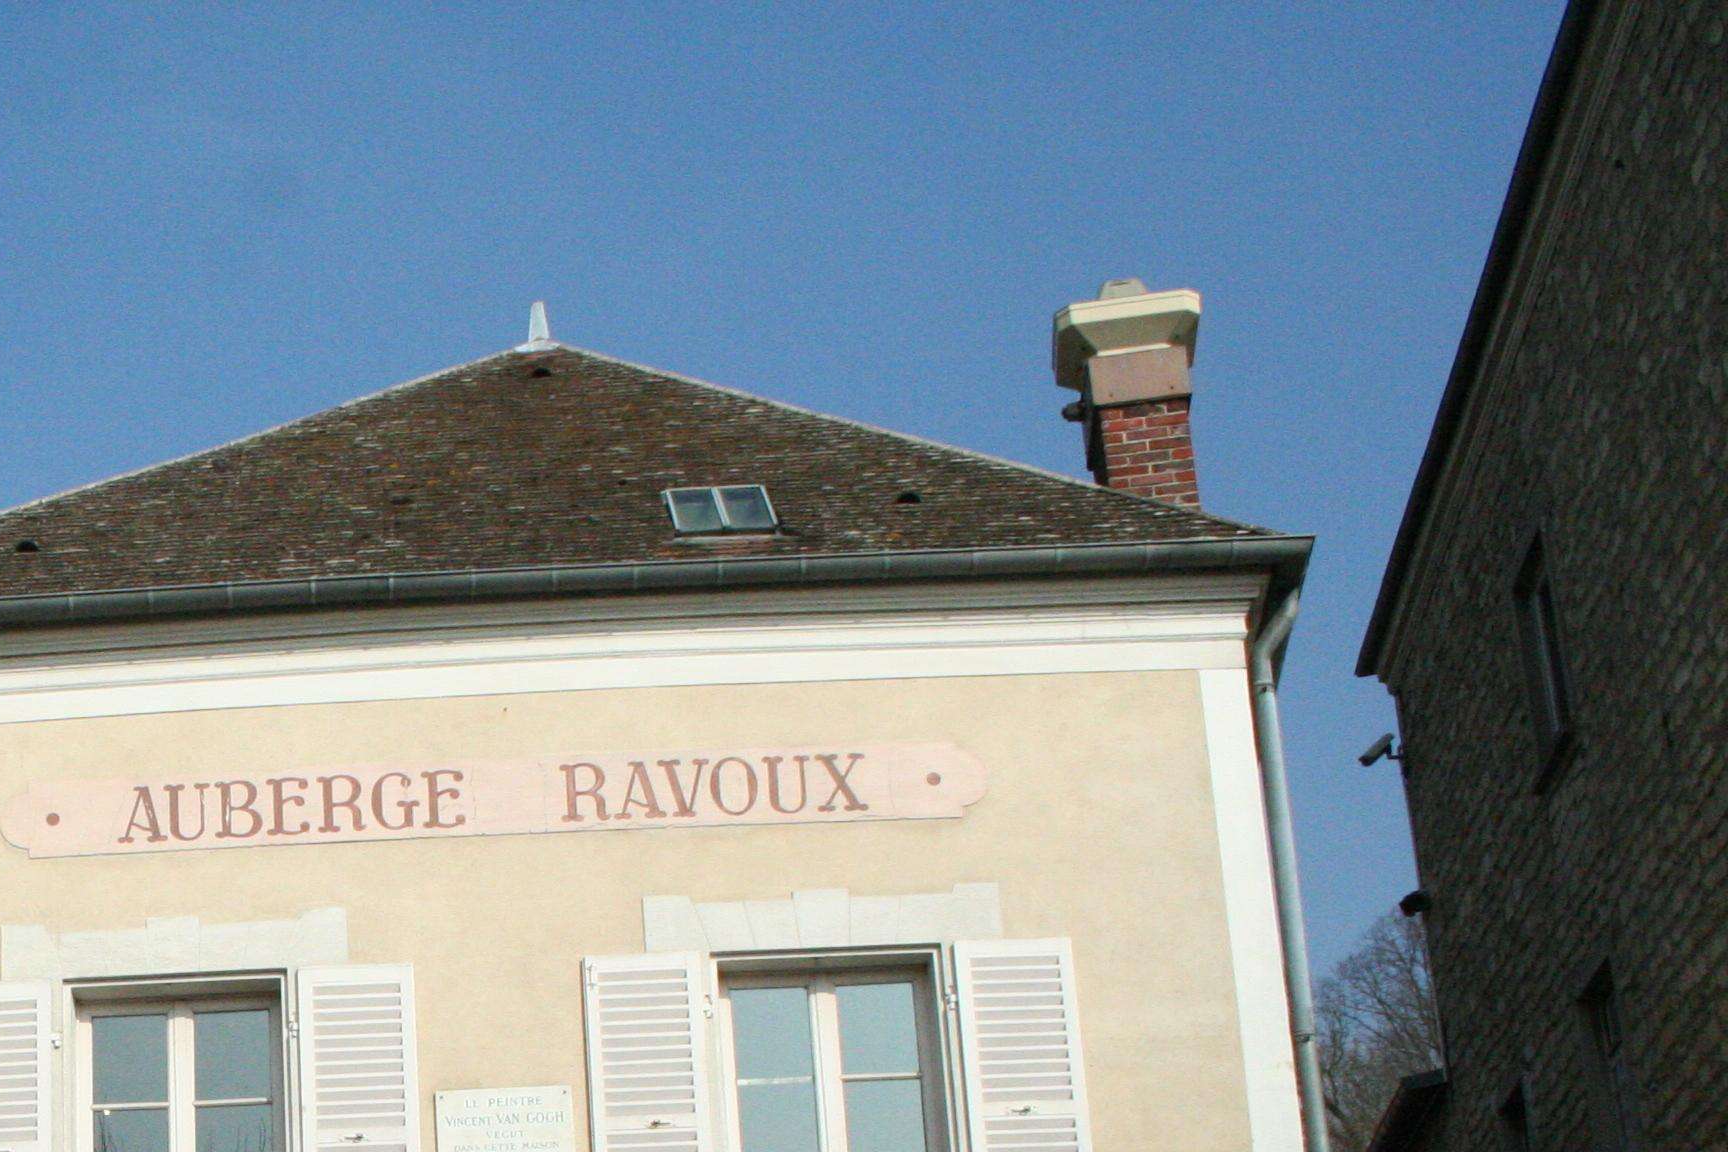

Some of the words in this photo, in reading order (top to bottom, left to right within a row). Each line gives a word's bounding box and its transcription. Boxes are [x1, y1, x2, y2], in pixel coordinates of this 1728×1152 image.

[117, 770, 467, 845] AUBERGE
[561, 753, 871, 825] RAVOUX
[488, 1096, 543, 1108] PEINTRE
[445, 1115, 493, 1128] VINCENT
[496, 1113, 520, 1125] VAN
[526, 1110, 565, 1125] GOGH
[523, 1141, 560, 1151] MAISON
